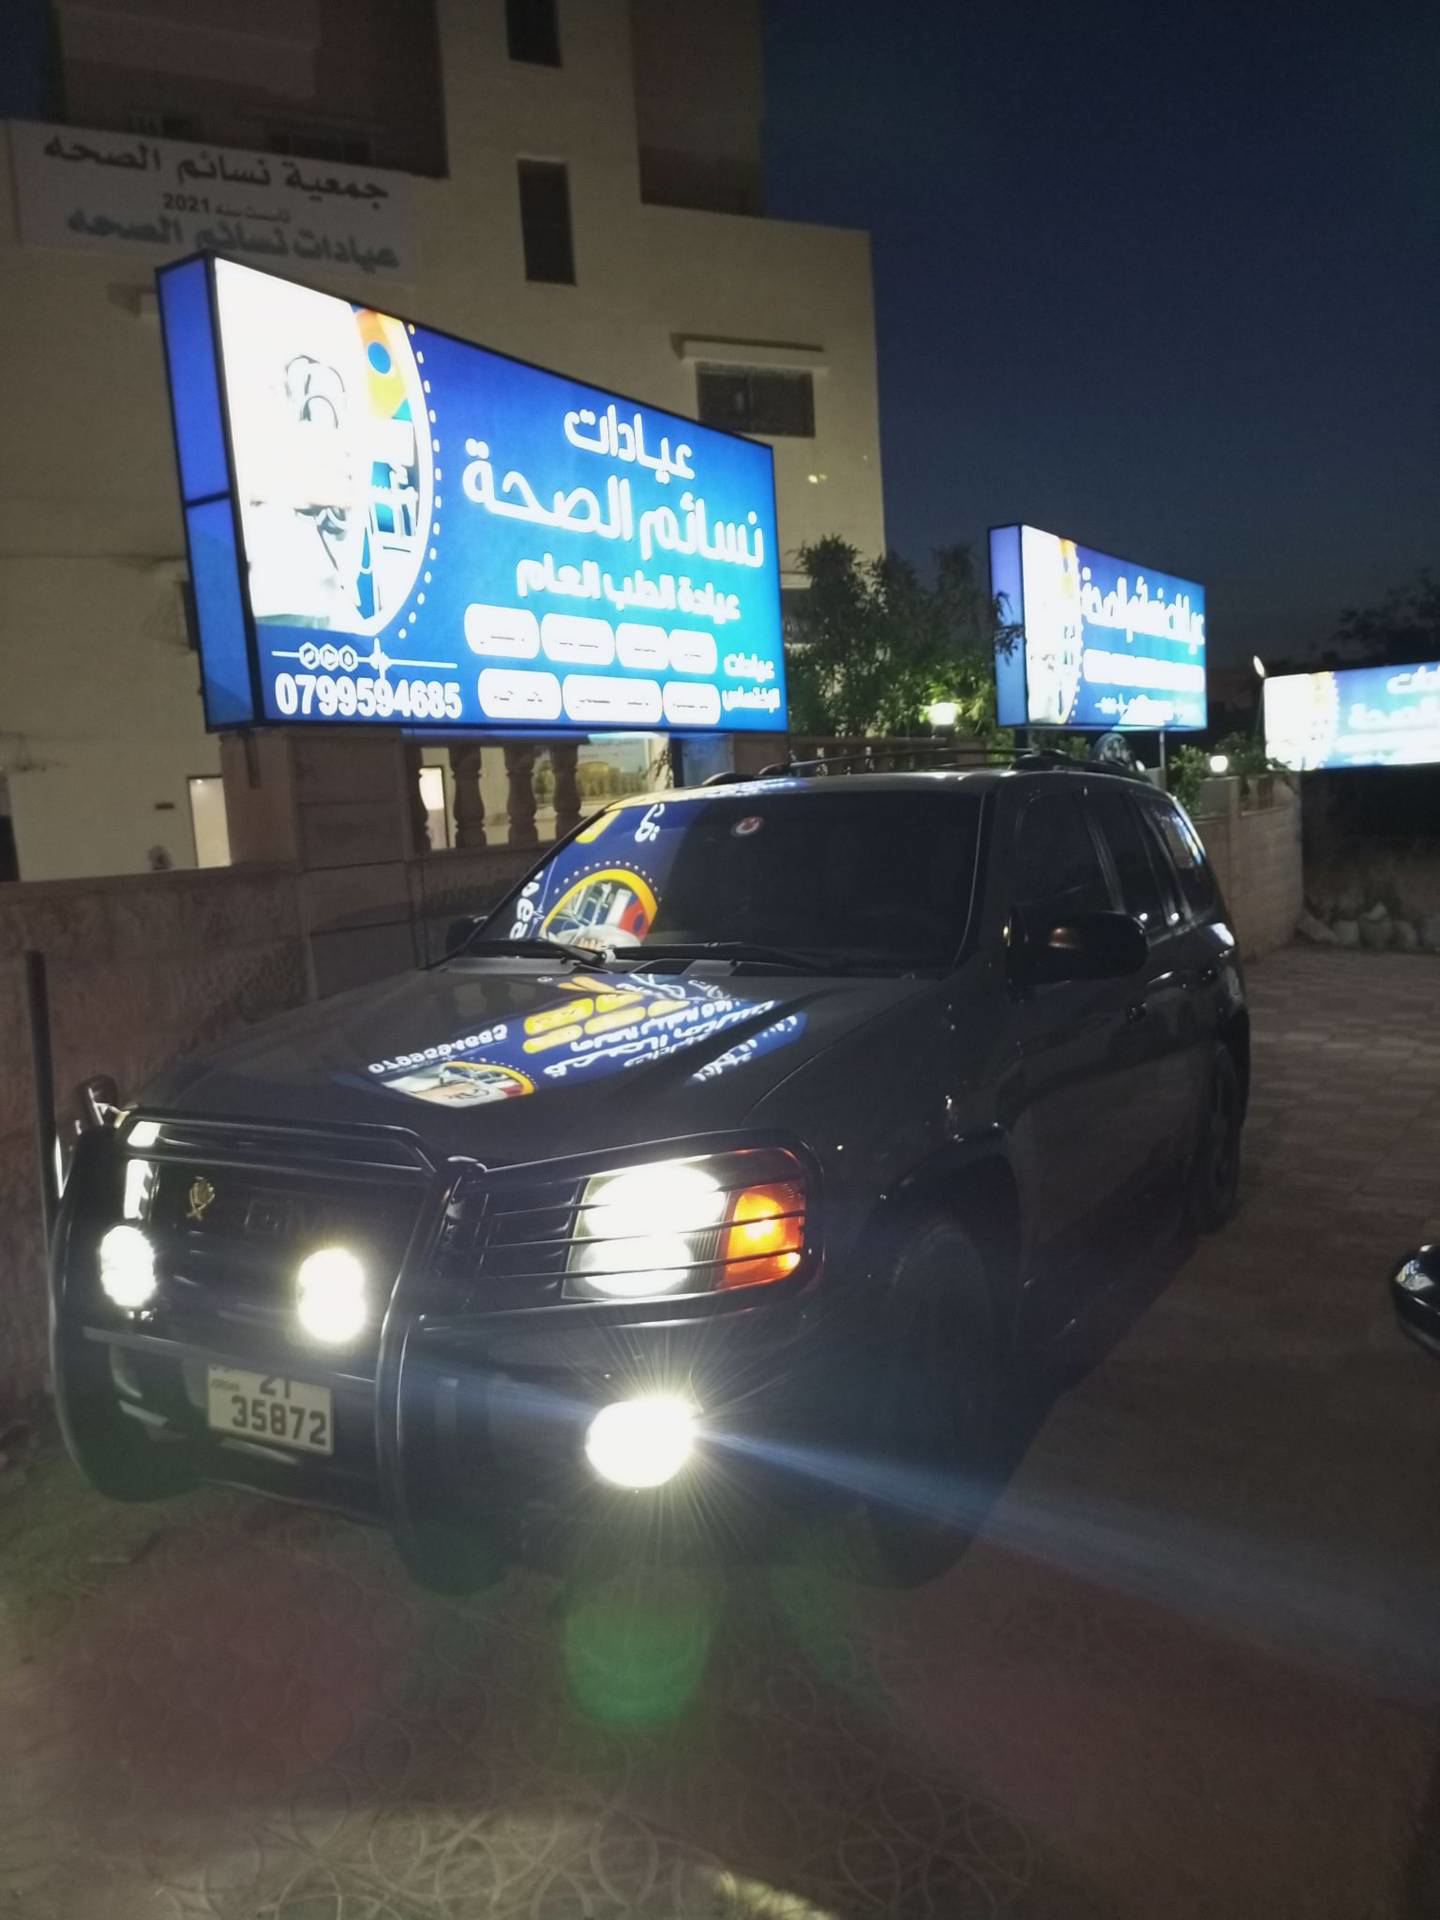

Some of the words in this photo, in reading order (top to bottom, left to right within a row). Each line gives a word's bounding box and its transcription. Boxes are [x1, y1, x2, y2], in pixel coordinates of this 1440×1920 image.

[177, 150, 270, 186] نسائم
[286, 160, 389, 209] جمعية
[163, 192, 210, 215] 2021
[564, 404, 695, 484] عيادات
[462, 437, 633, 542] الصحة
[640, 491, 764, 568] نسائم
[516, 552, 601, 599] العام
[603, 569, 677, 612] الطب
[678, 575, 741, 624] عيادة
[275, 672, 463, 719] 0799594685
[231, 1395, 327, 1447] 35872
